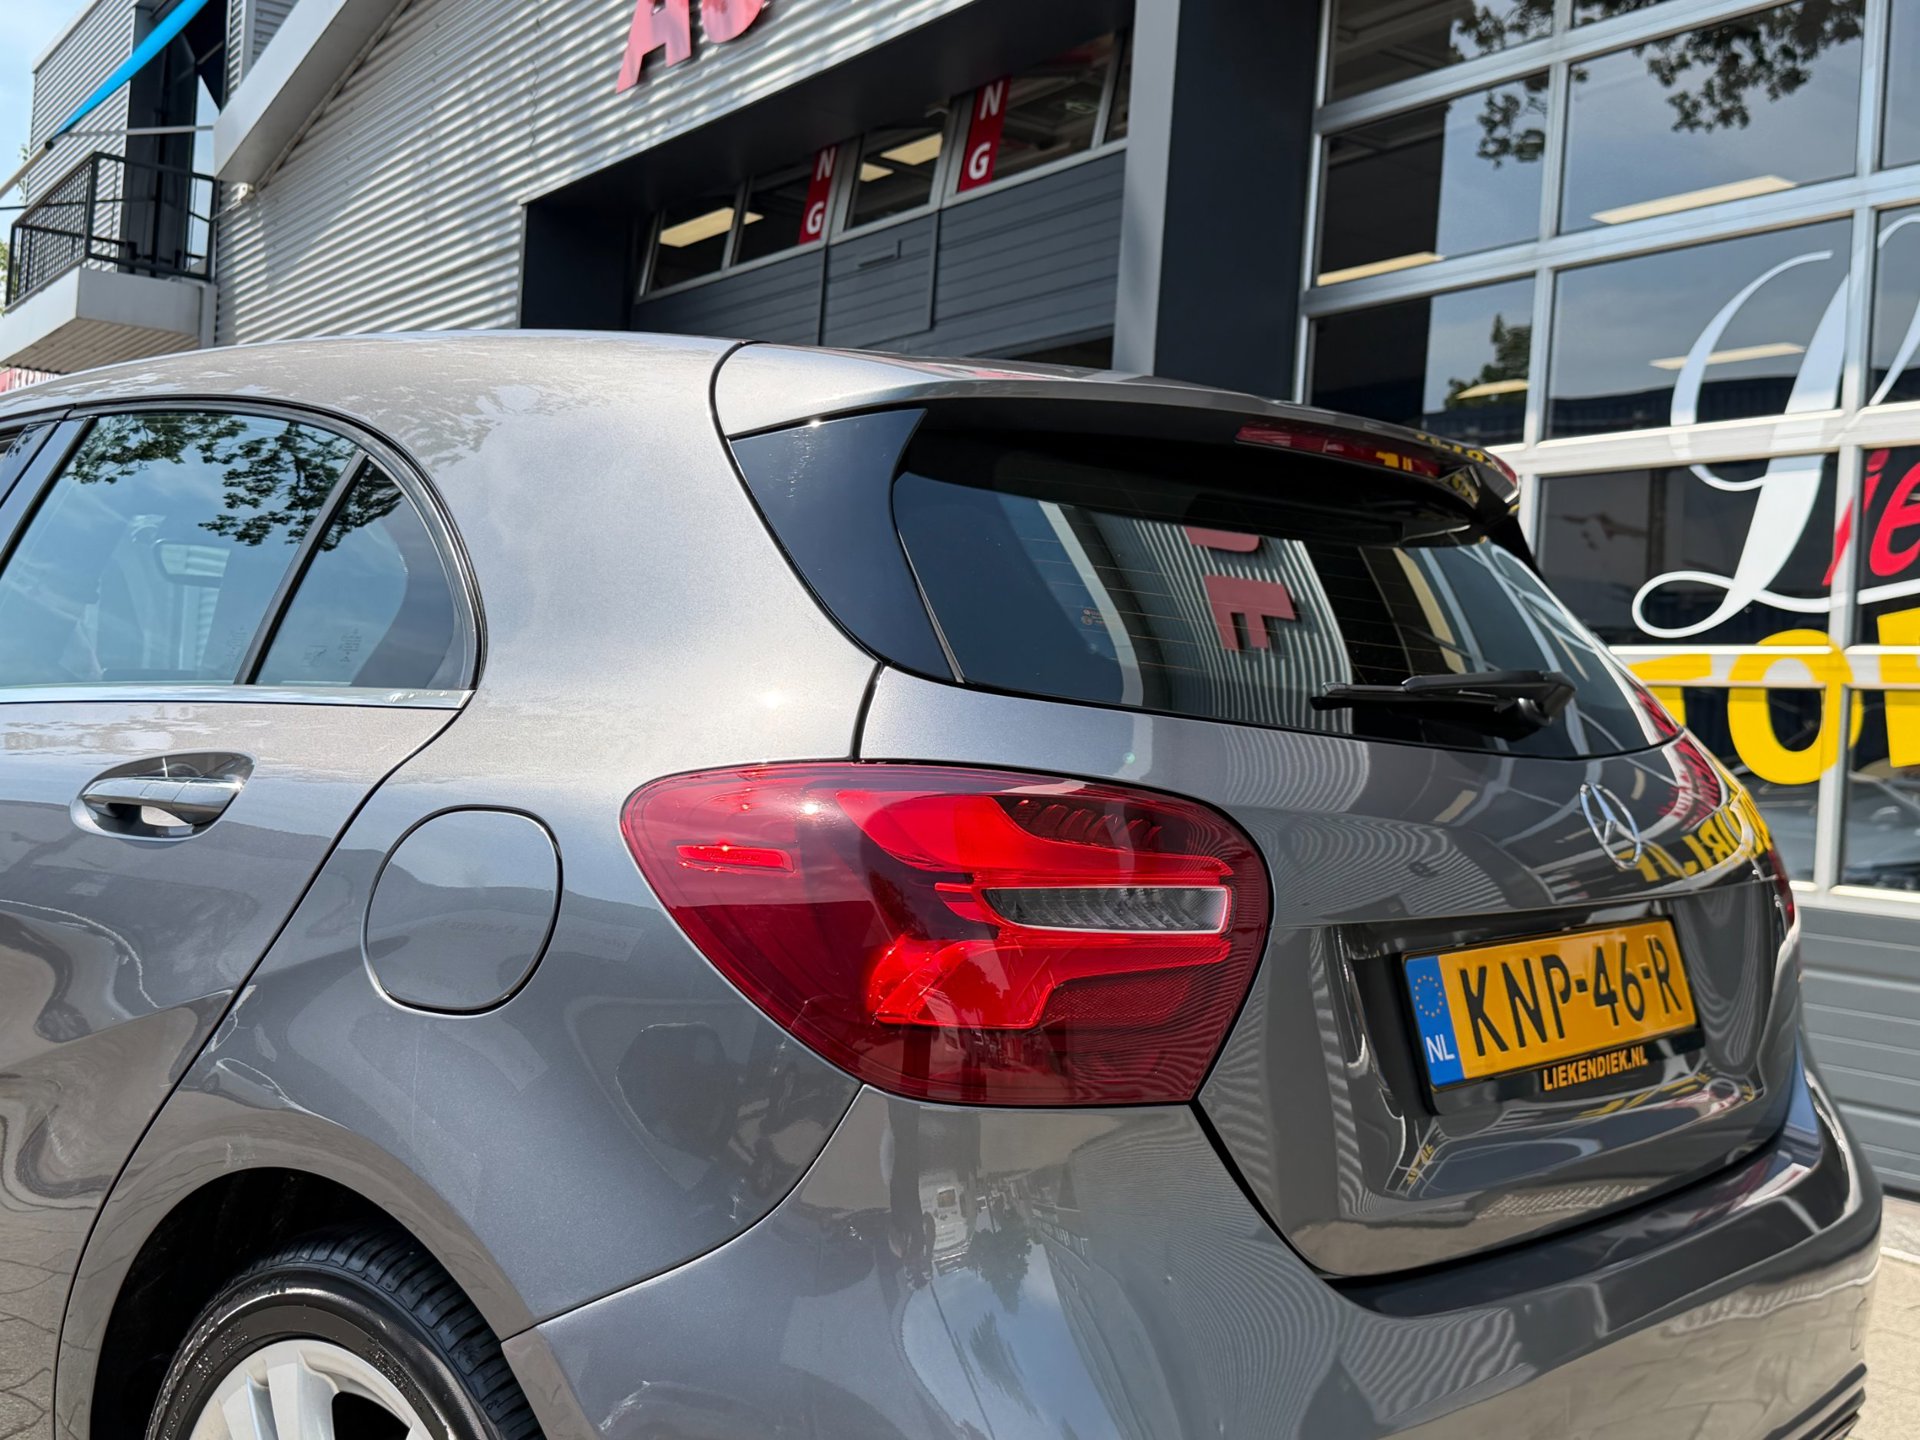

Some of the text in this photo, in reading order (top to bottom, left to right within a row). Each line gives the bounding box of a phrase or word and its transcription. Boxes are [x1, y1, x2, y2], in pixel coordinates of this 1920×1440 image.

[1460, 936, 1683, 1057] KNP-46-R
[1425, 1033, 1455, 1064] NL
[1543, 1046, 1648, 1091] LIEKENDIEK.NL
